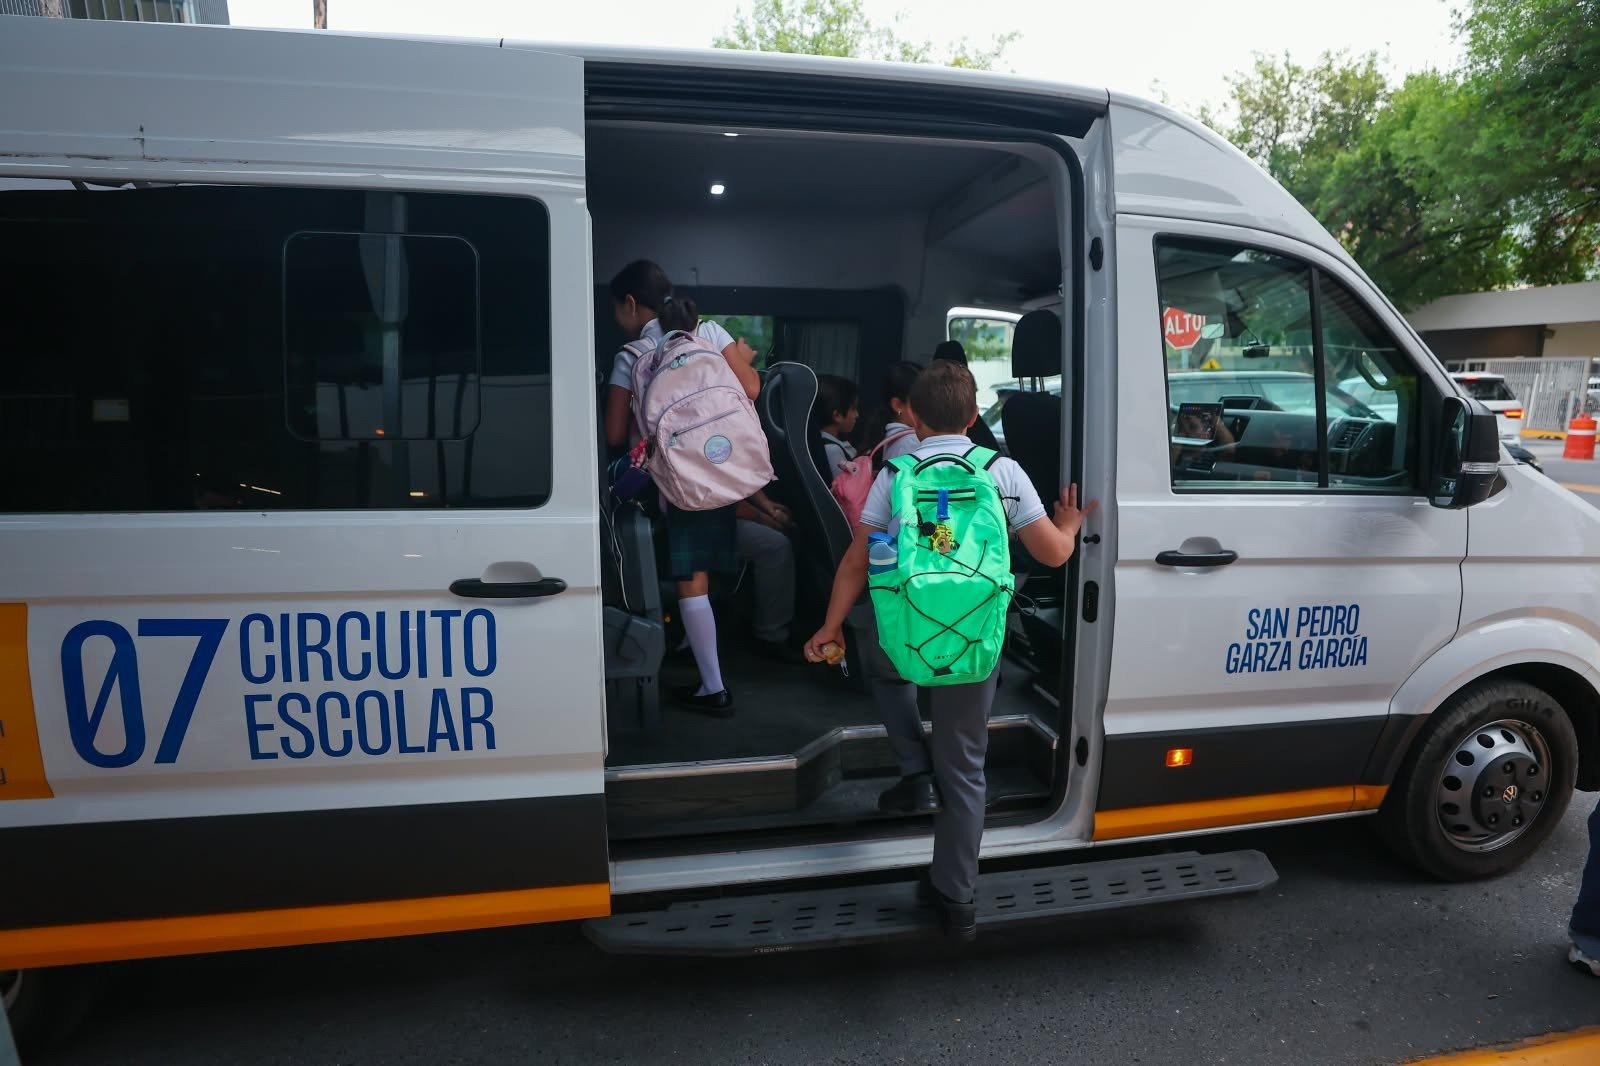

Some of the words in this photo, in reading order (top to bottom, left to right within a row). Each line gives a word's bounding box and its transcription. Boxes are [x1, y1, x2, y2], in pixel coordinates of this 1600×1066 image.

[1165, 313, 1201, 336] ALTO
[239, 607, 499, 685] CIRCUITO
[1246, 607, 1290, 640] SAN
[1296, 603, 1360, 637] PEDRO
[1225, 640, 1292, 674] GARZA
[1298, 634, 1368, 670] GARCÍA
[60, 617, 231, 767] 07
[243, 686, 496, 760] ESCOLAR
